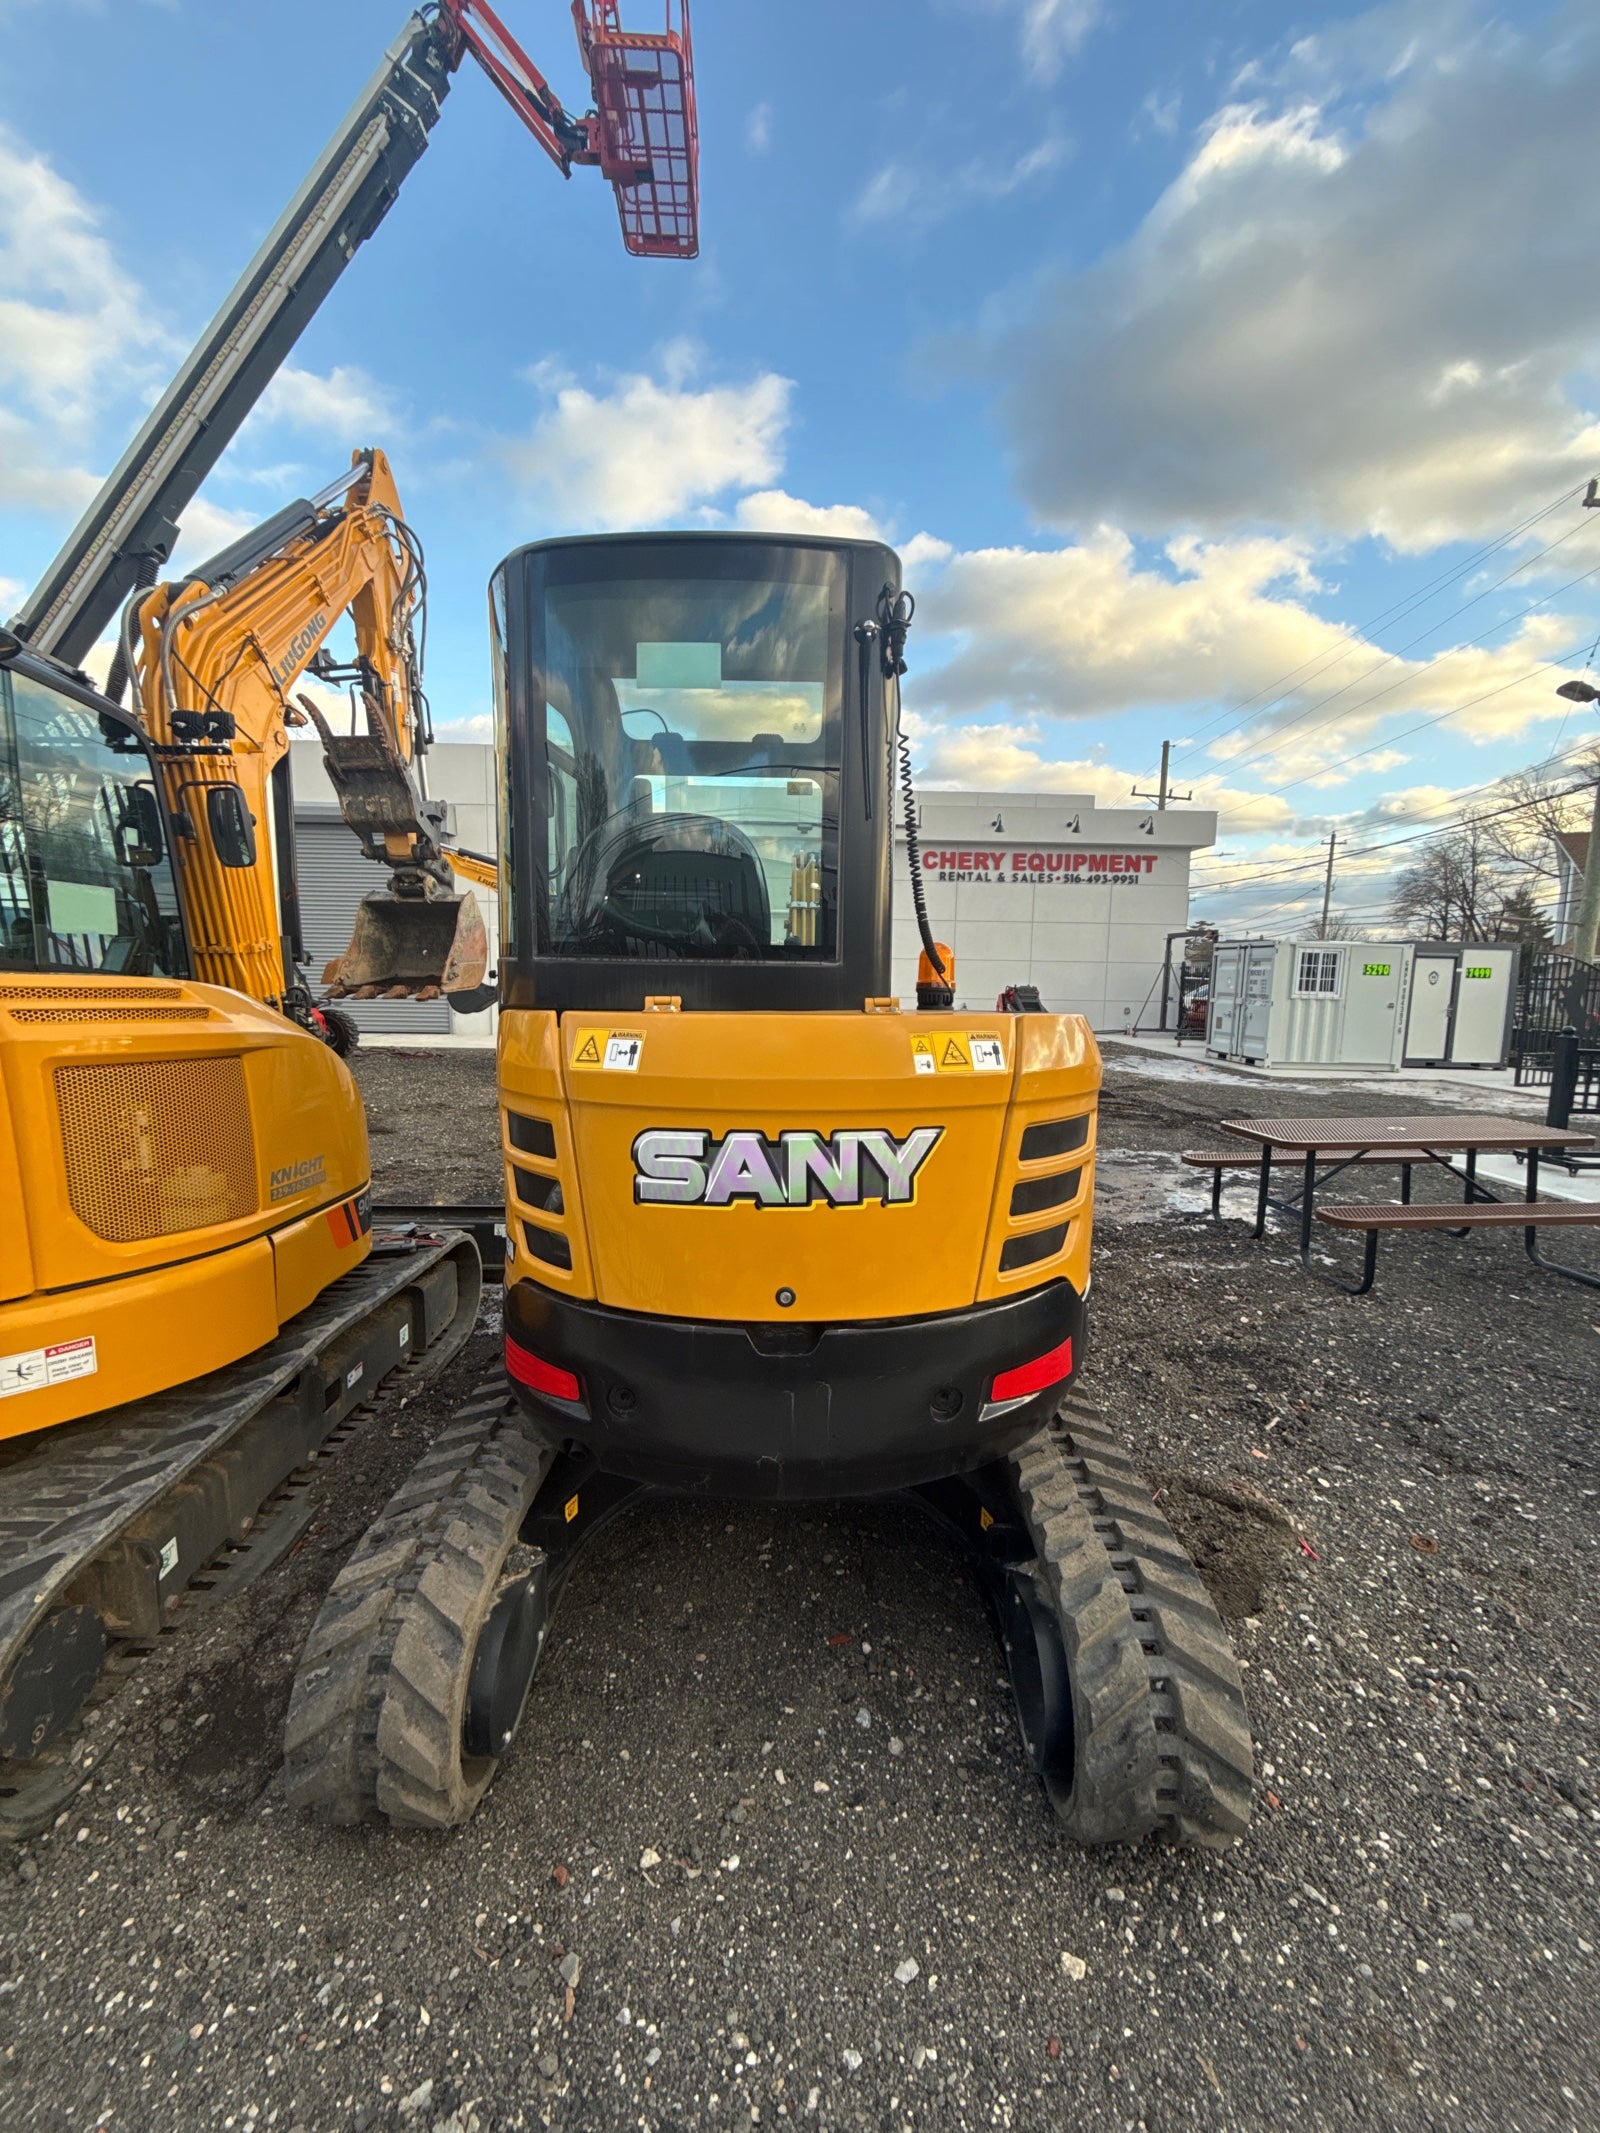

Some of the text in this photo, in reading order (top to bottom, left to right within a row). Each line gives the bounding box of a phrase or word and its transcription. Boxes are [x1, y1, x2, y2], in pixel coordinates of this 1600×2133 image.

[922, 850, 1158, 873] CHERY EQUIPMENT
[938, 871, 1139, 884] RENTAL & SALES 516-493-9951
[617, 1031, 643, 1039] WARNING
[270, 1154, 325, 1188] KNIGHT
[634, 1128, 944, 1209] SANY
[57, 1340, 90, 1354] DANGER
